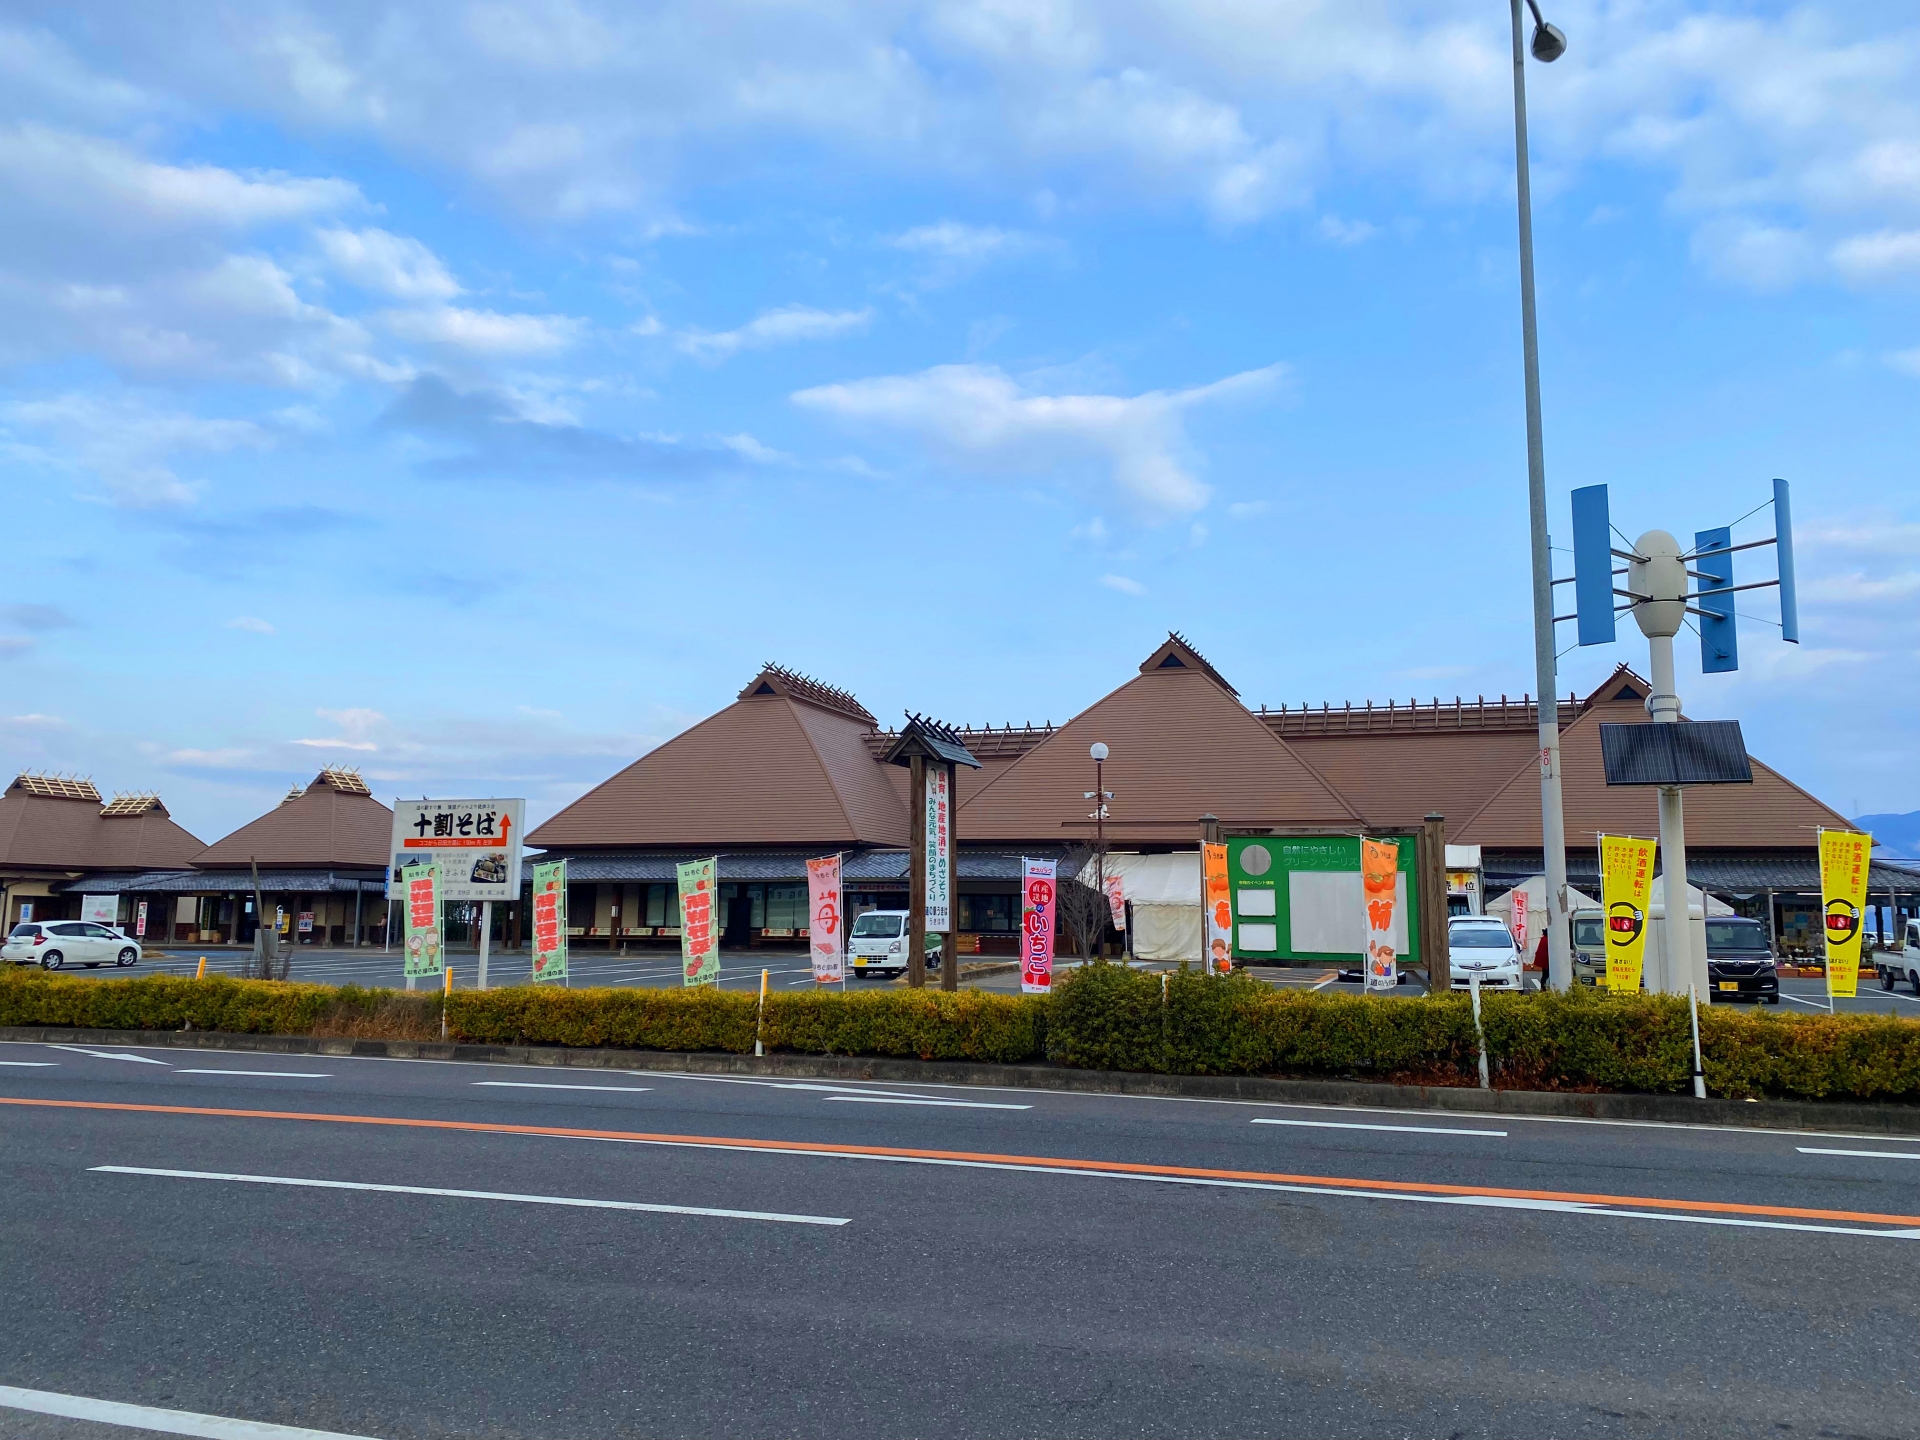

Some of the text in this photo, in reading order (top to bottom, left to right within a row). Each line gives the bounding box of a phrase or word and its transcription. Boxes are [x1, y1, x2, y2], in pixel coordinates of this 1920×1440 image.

[413, 811, 497, 837] 十割そば
[937, 772, 947, 902] 食育・地産地消でめざそう
[928, 797, 936, 902] みんな元気、笑顔のまちづくり
[1283, 845, 1346, 855] 自然にやさしい
[1029, 866, 1053, 874] ゆうパック
[1633, 847, 1649, 901] 飲酒運転は、
[1850, 841, 1863, 898] 飲酒運転は、
[1367, 900, 1393, 931] 柿
[1516, 898, 1526, 940] 花コーナー
[1610, 916, 1634, 931] NO!
[1828, 916, 1851, 929] NO!
[1029, 915, 1049, 975] いちご
